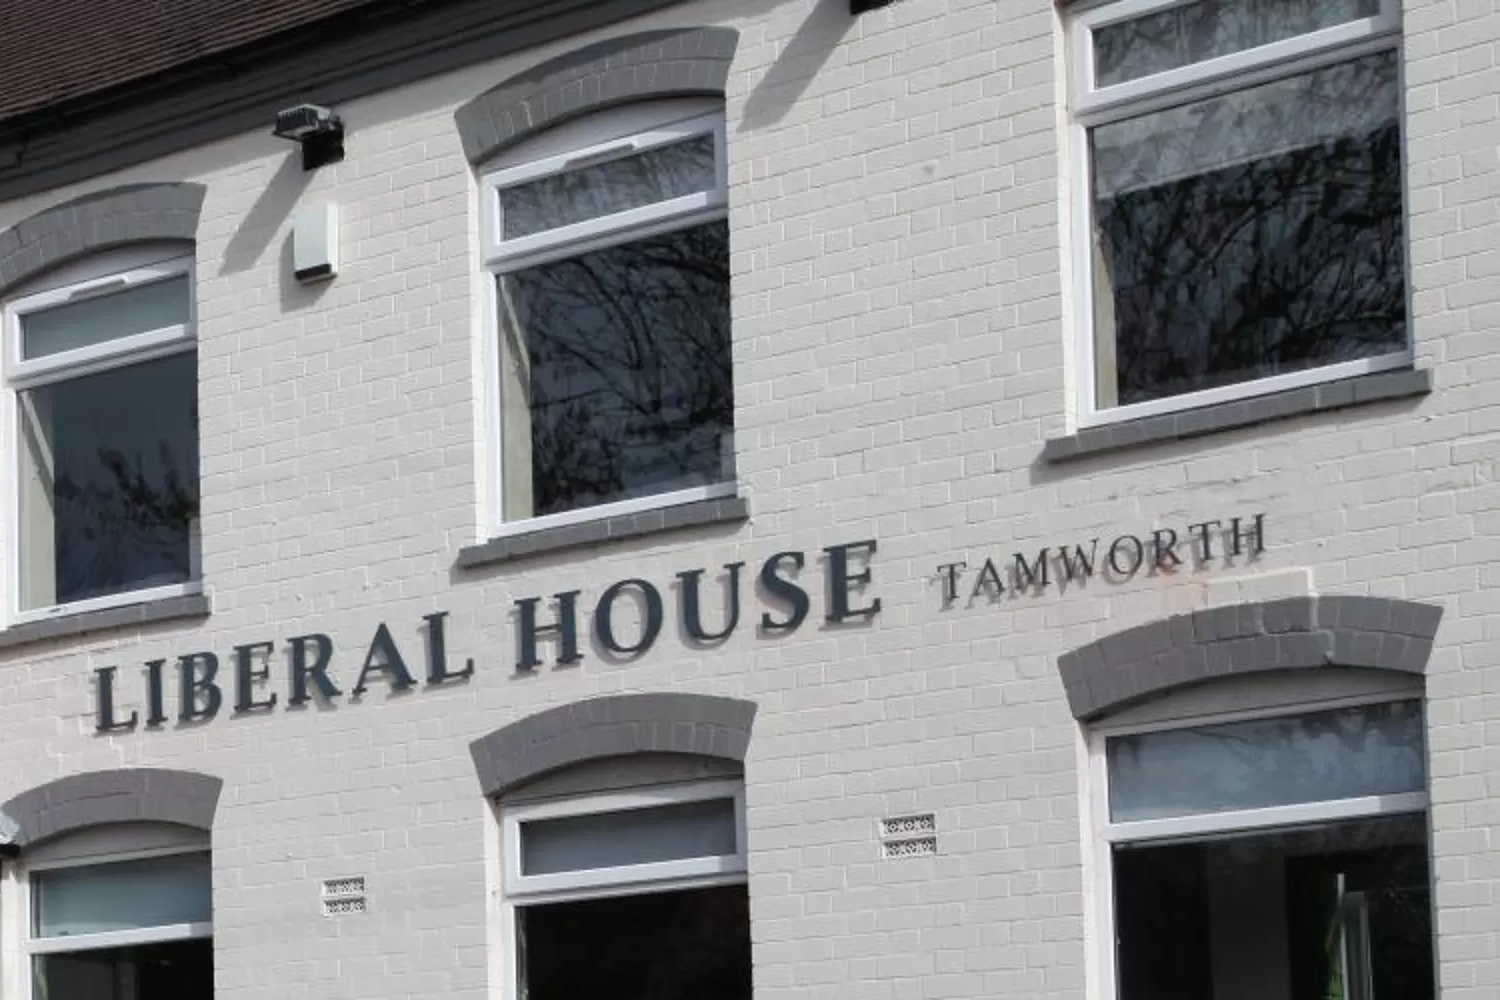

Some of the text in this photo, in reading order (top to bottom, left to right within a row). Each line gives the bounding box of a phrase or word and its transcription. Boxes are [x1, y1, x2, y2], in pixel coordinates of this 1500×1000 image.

[93, 512, 1267, 732] LIBERAL HOUSE TAMWORTH
